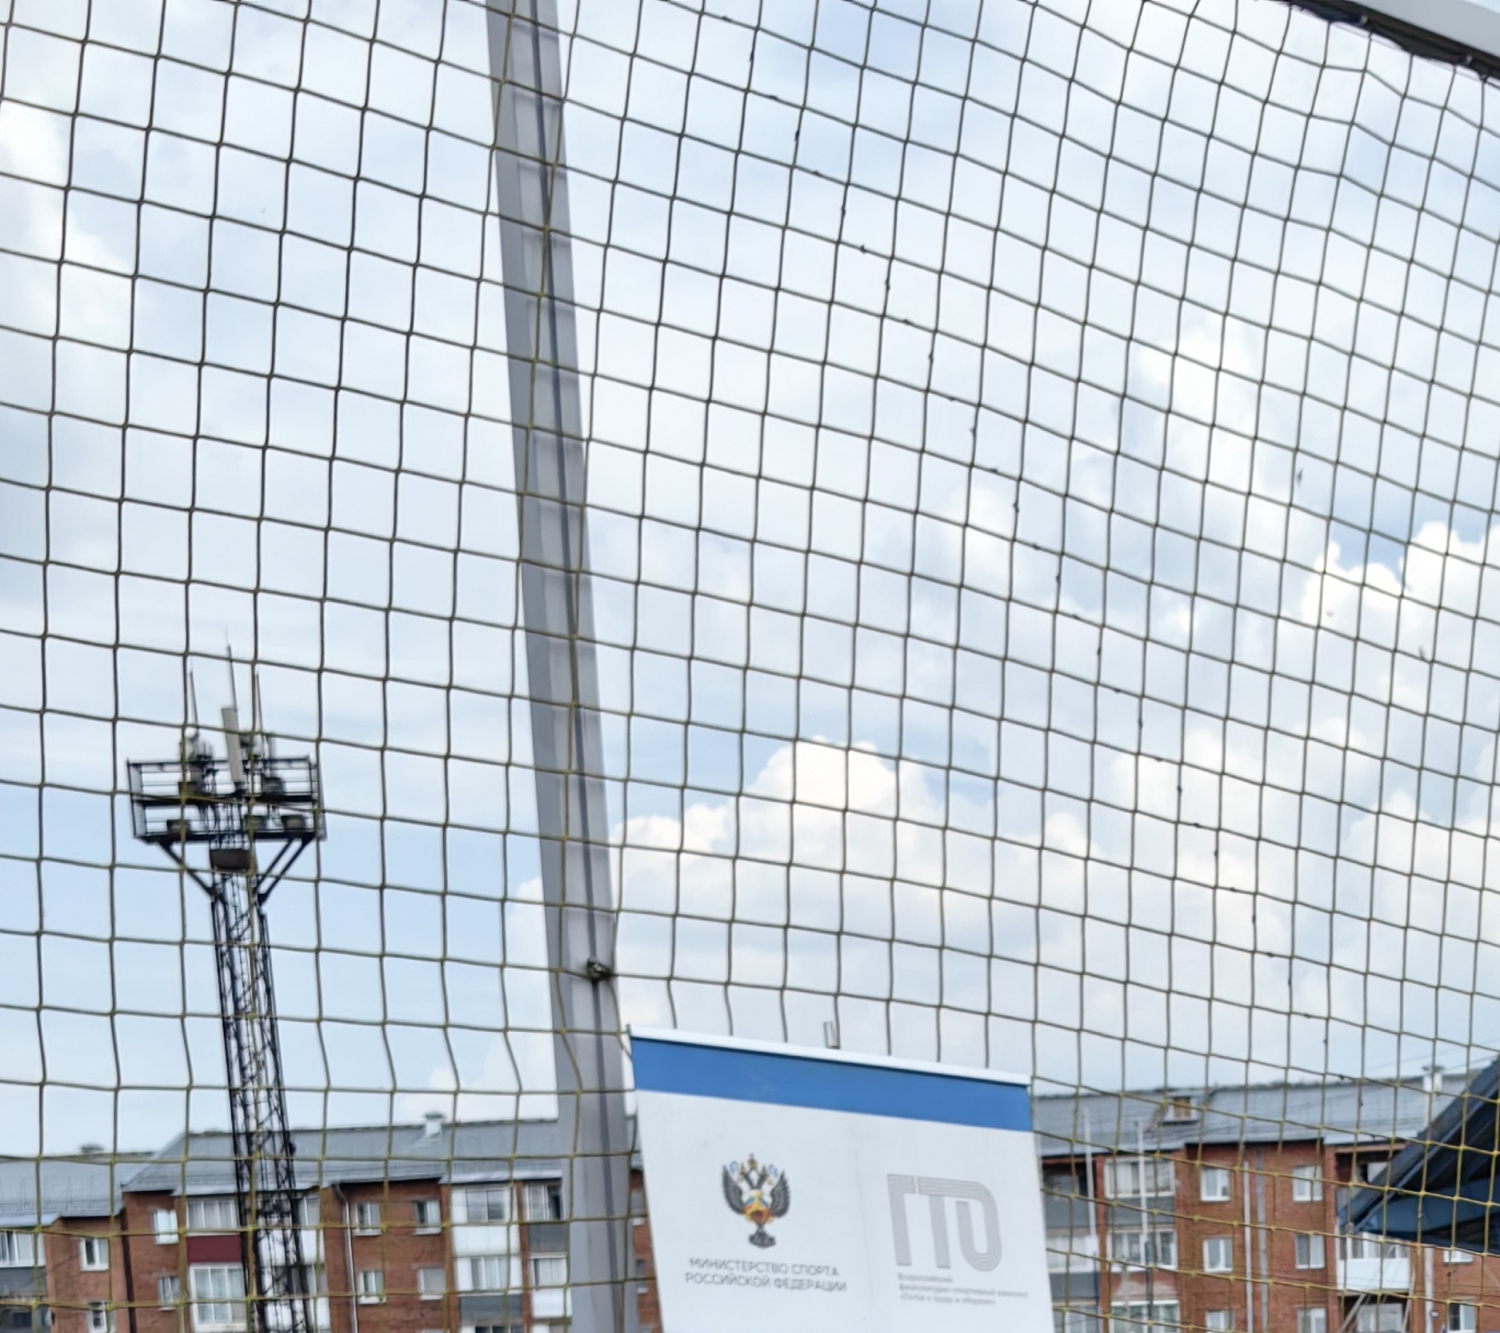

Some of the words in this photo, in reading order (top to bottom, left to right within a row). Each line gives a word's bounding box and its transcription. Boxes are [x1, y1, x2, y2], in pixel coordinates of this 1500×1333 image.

[887, 1174, 1002, 1272] ГТО
[689, 1257, 788, 1275] МИНИСТЕРСТВО
[791, 1263, 840, 1277] СПОРТА
[685, 1271, 770, 1289] РОССИЙСКОЙ
[773, 1277, 848, 1293] ФЕДЕРАЦИИ
